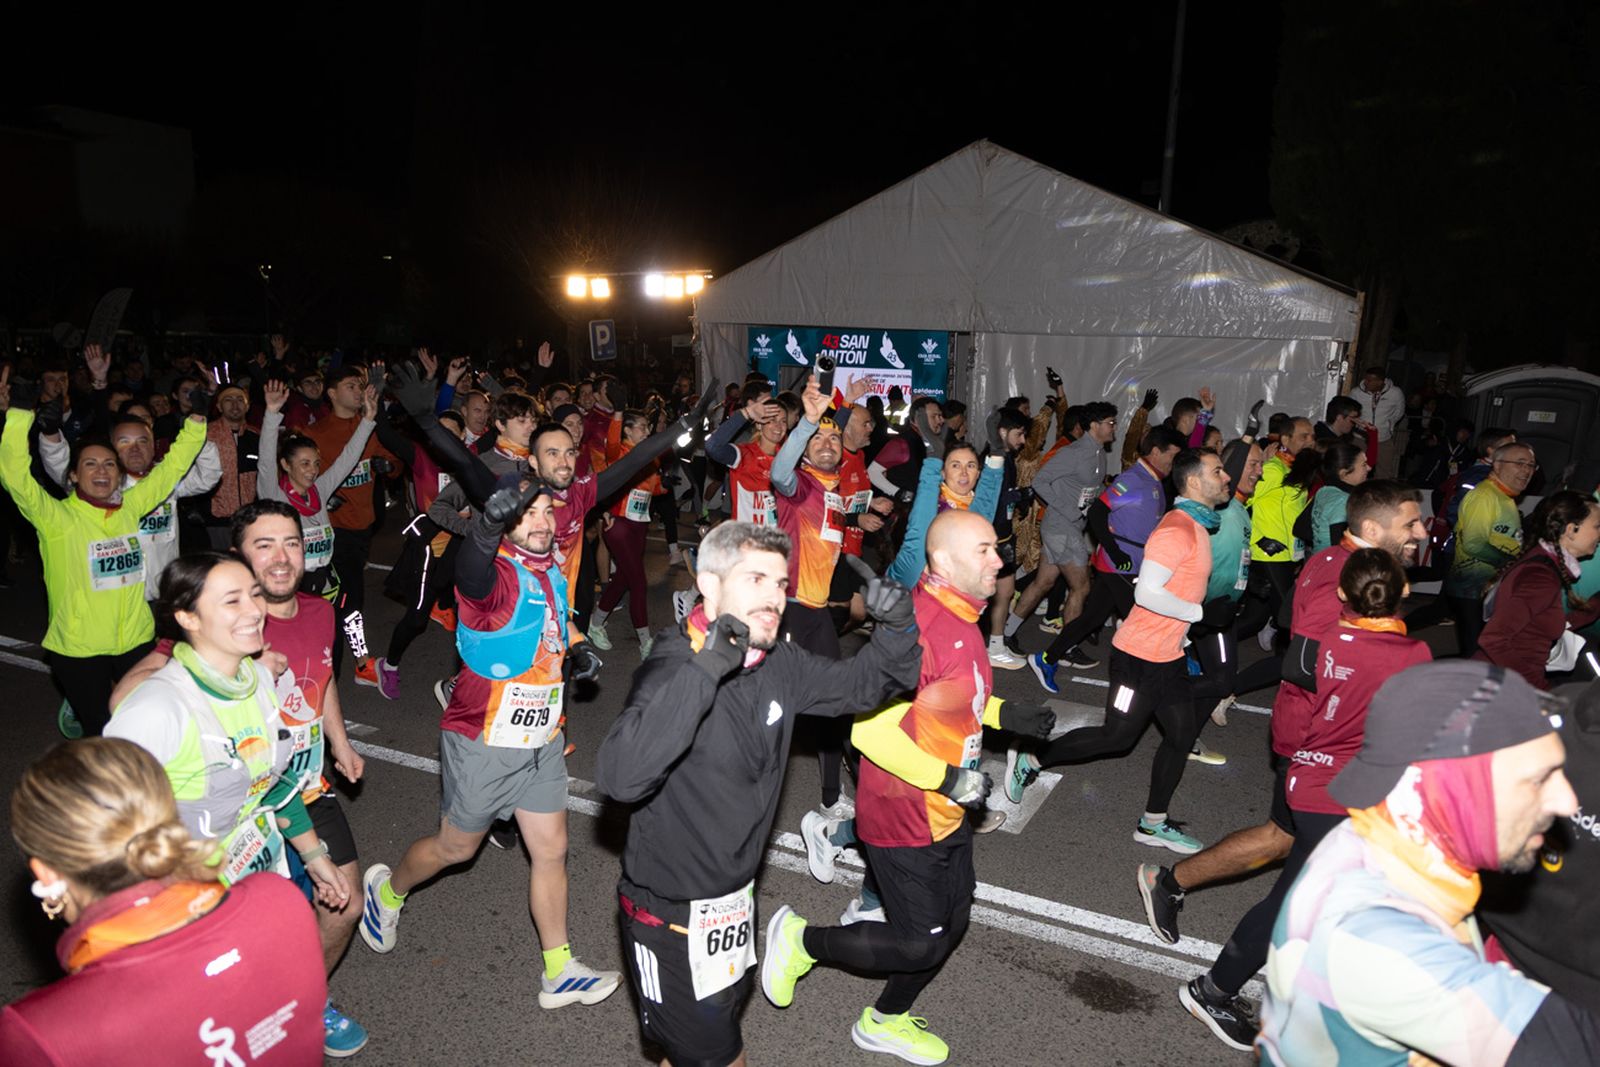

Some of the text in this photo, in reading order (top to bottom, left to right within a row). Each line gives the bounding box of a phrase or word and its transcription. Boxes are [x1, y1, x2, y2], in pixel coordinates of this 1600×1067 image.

[596, 325, 609, 346] P
[822, 334, 870, 349] 43 SAN
[98, 551, 140, 573] 12865
[284, 693, 303, 713] 43
[511, 707, 550, 727] 6679
[699, 917, 718, 929] SAN
[707, 921, 751, 957] 668
